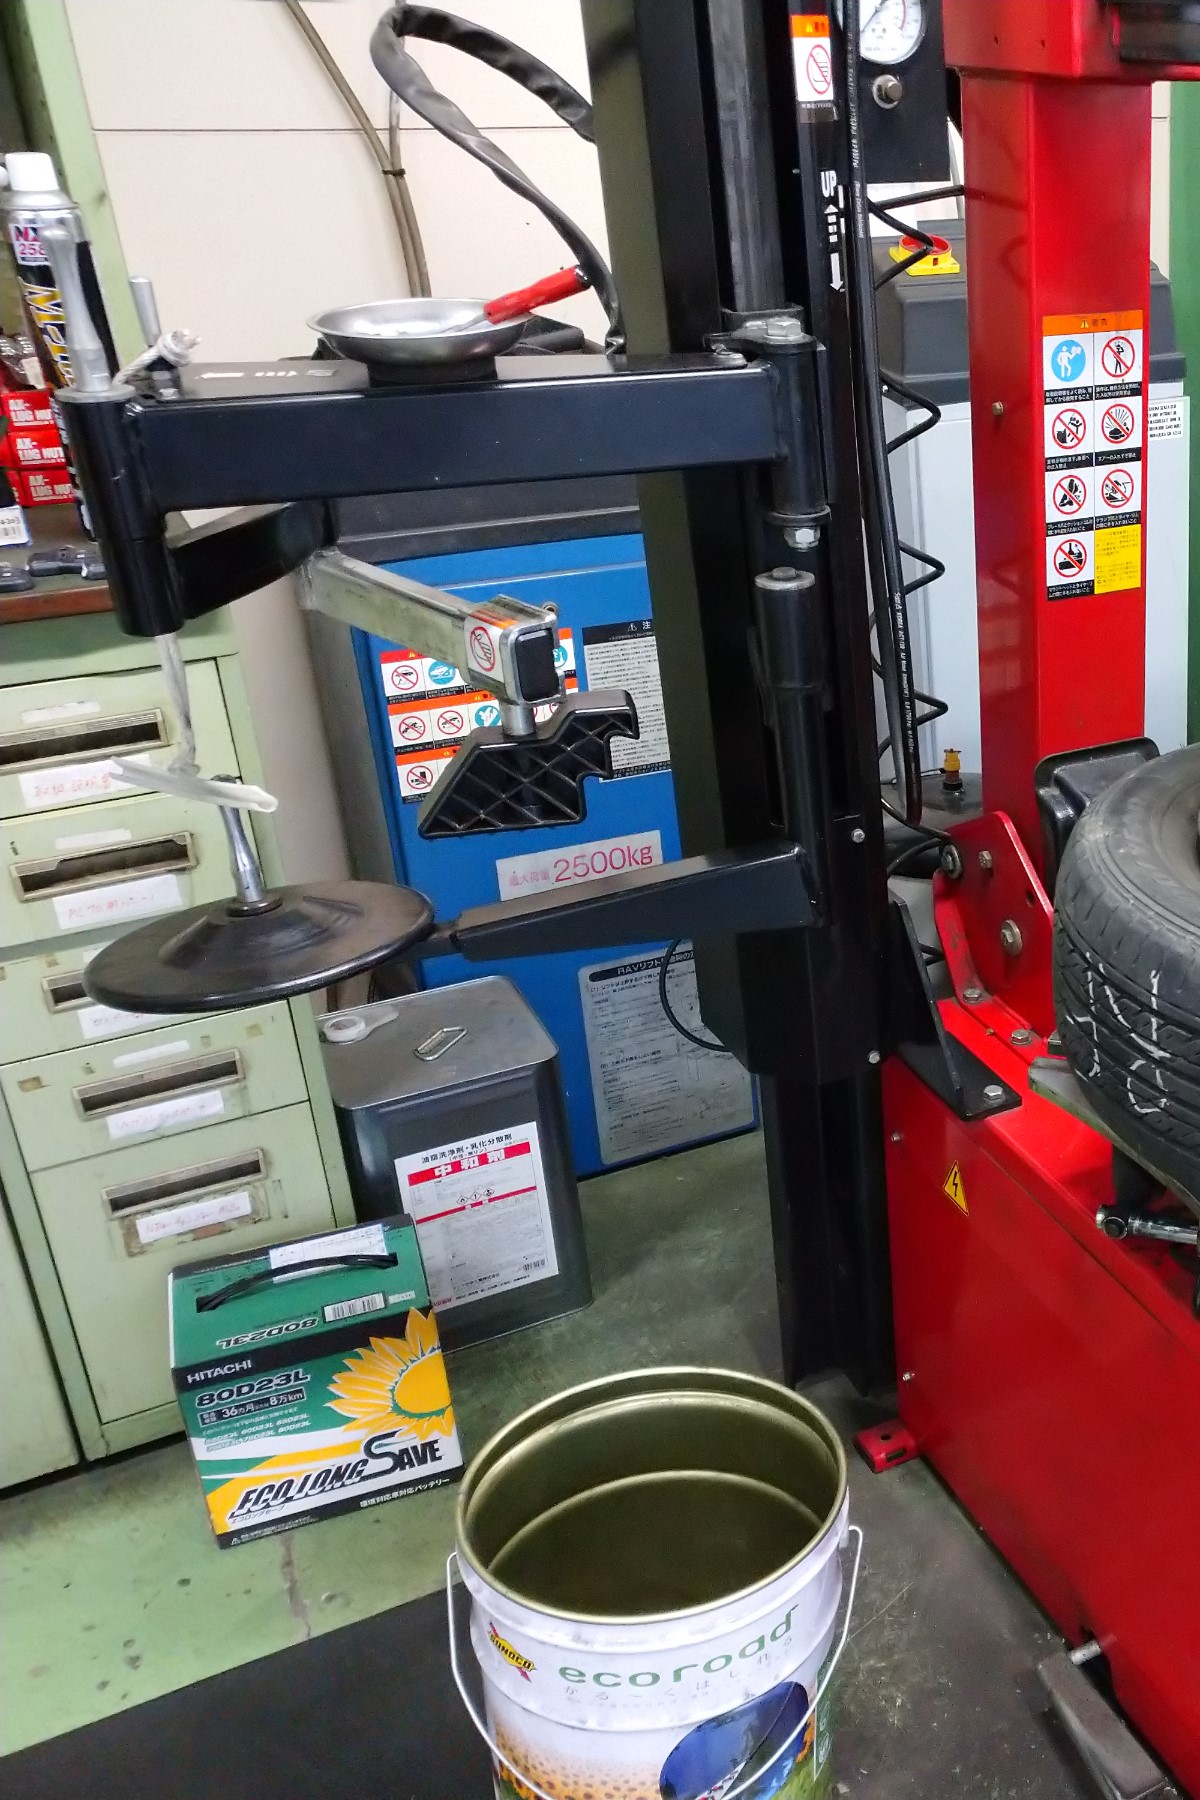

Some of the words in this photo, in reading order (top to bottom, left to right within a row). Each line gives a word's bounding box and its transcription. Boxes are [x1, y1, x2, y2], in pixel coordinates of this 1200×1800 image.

[820, 170, 837, 198] UP
[18, 448, 42, 461] LUG
[553, 845, 653, 883] 2500kg
[433, 1148, 506, 1177] 中和剤
[216, 1317, 319, 1350] 80D23L
[187, 1359, 252, 1383] HITACHI
[195, 1369, 311, 1408] 80D23L
[228, 1478, 296, 1519] ECO
[296, 1458, 369, 1498] LONG
[360, 1428, 443, 1480] SAVE
[488, 1632, 534, 1671] SUNOCO
[559, 1604, 799, 1687] ecoroad
